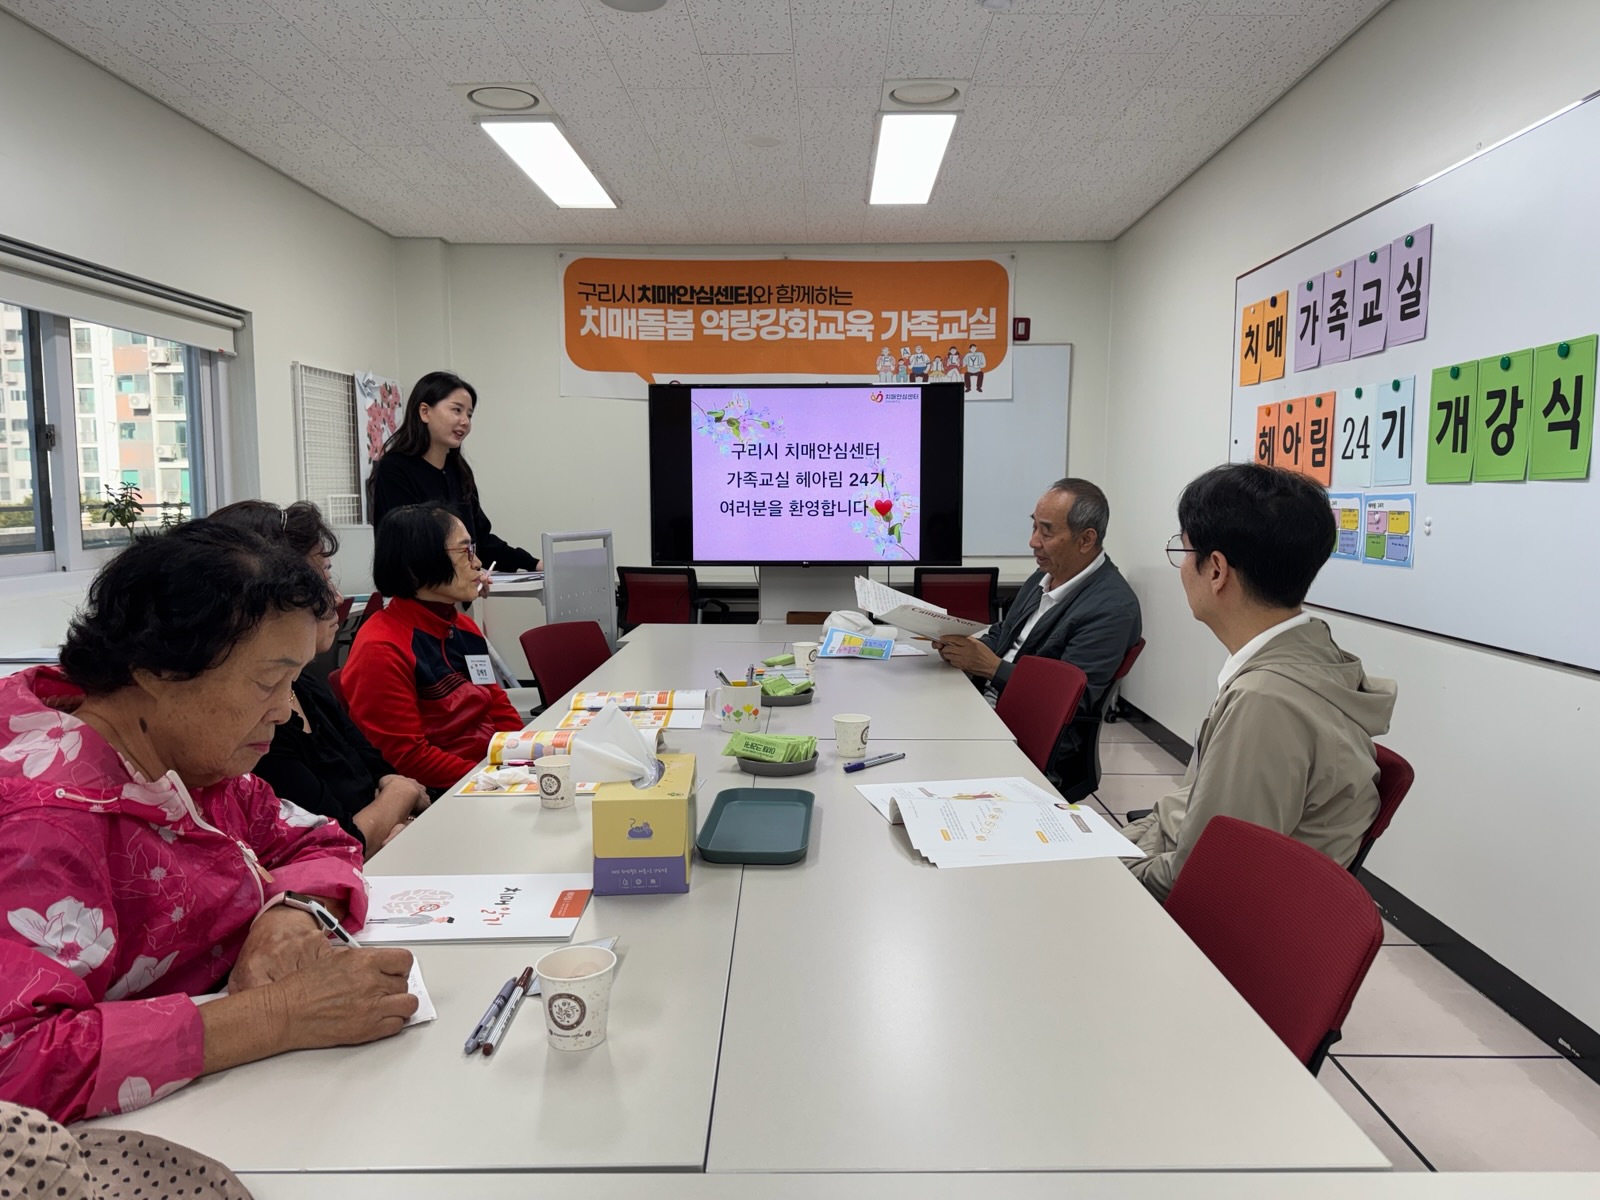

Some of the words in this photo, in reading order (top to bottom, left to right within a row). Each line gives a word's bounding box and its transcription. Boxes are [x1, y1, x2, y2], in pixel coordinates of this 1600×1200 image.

[776, 283, 853, 306] 함께하는
[1244, 315, 1284, 364] 치매
[1299, 256, 1424, 346] 가족교실
[580, 305, 695, 341] 치매돌봄
[700, 308, 875, 341] 역량강화교육
[880, 307, 997, 341] 가족교실
[1259, 417, 1329, 467] 헤아림
[1341, 406, 1406, 459] 24기
[1435, 375, 1584, 457] 개강식
[731, 442, 778, 460] 구리시
[785, 442, 880, 460] 치매안심센터
[727, 471, 790, 488] 가족교실
[796, 471, 843, 488] 헤아림
[849, 472, 885, 488] 24기
[720, 499, 783, 517] 여러분을
[789, 499, 869, 518] 환영합니다
[912, 608, 950, 621] Campus
[953, 618, 976, 626] Note
[494, 887, 522, 905] 치매
